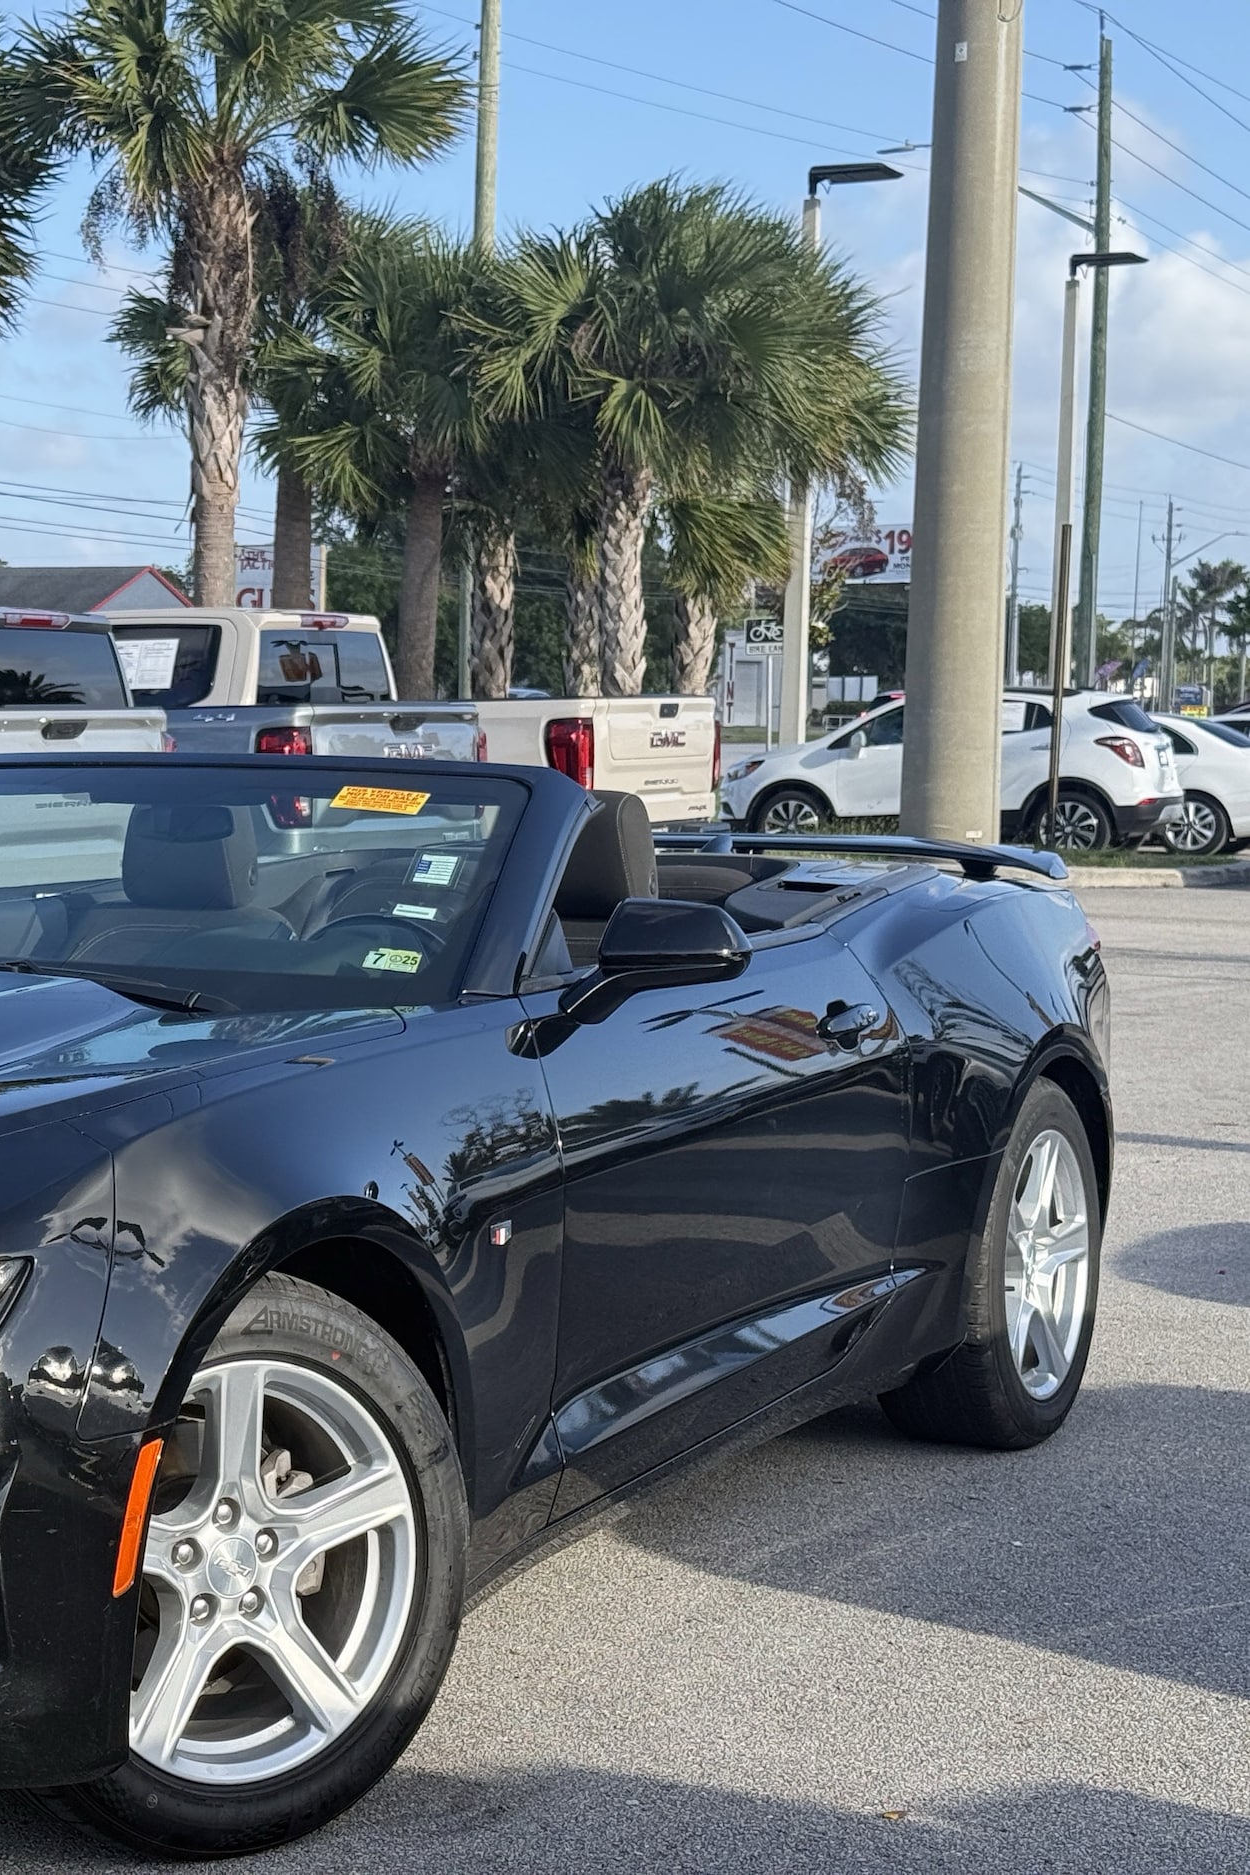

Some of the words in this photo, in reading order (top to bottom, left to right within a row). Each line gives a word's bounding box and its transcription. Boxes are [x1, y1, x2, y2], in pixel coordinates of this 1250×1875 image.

[769, 645, 783, 653] LAN
[726, 643, 736, 723] TINT
[650, 730, 685, 748] GMC
[372, 952, 387, 965] 7
[402, 955, 419, 966] 25
